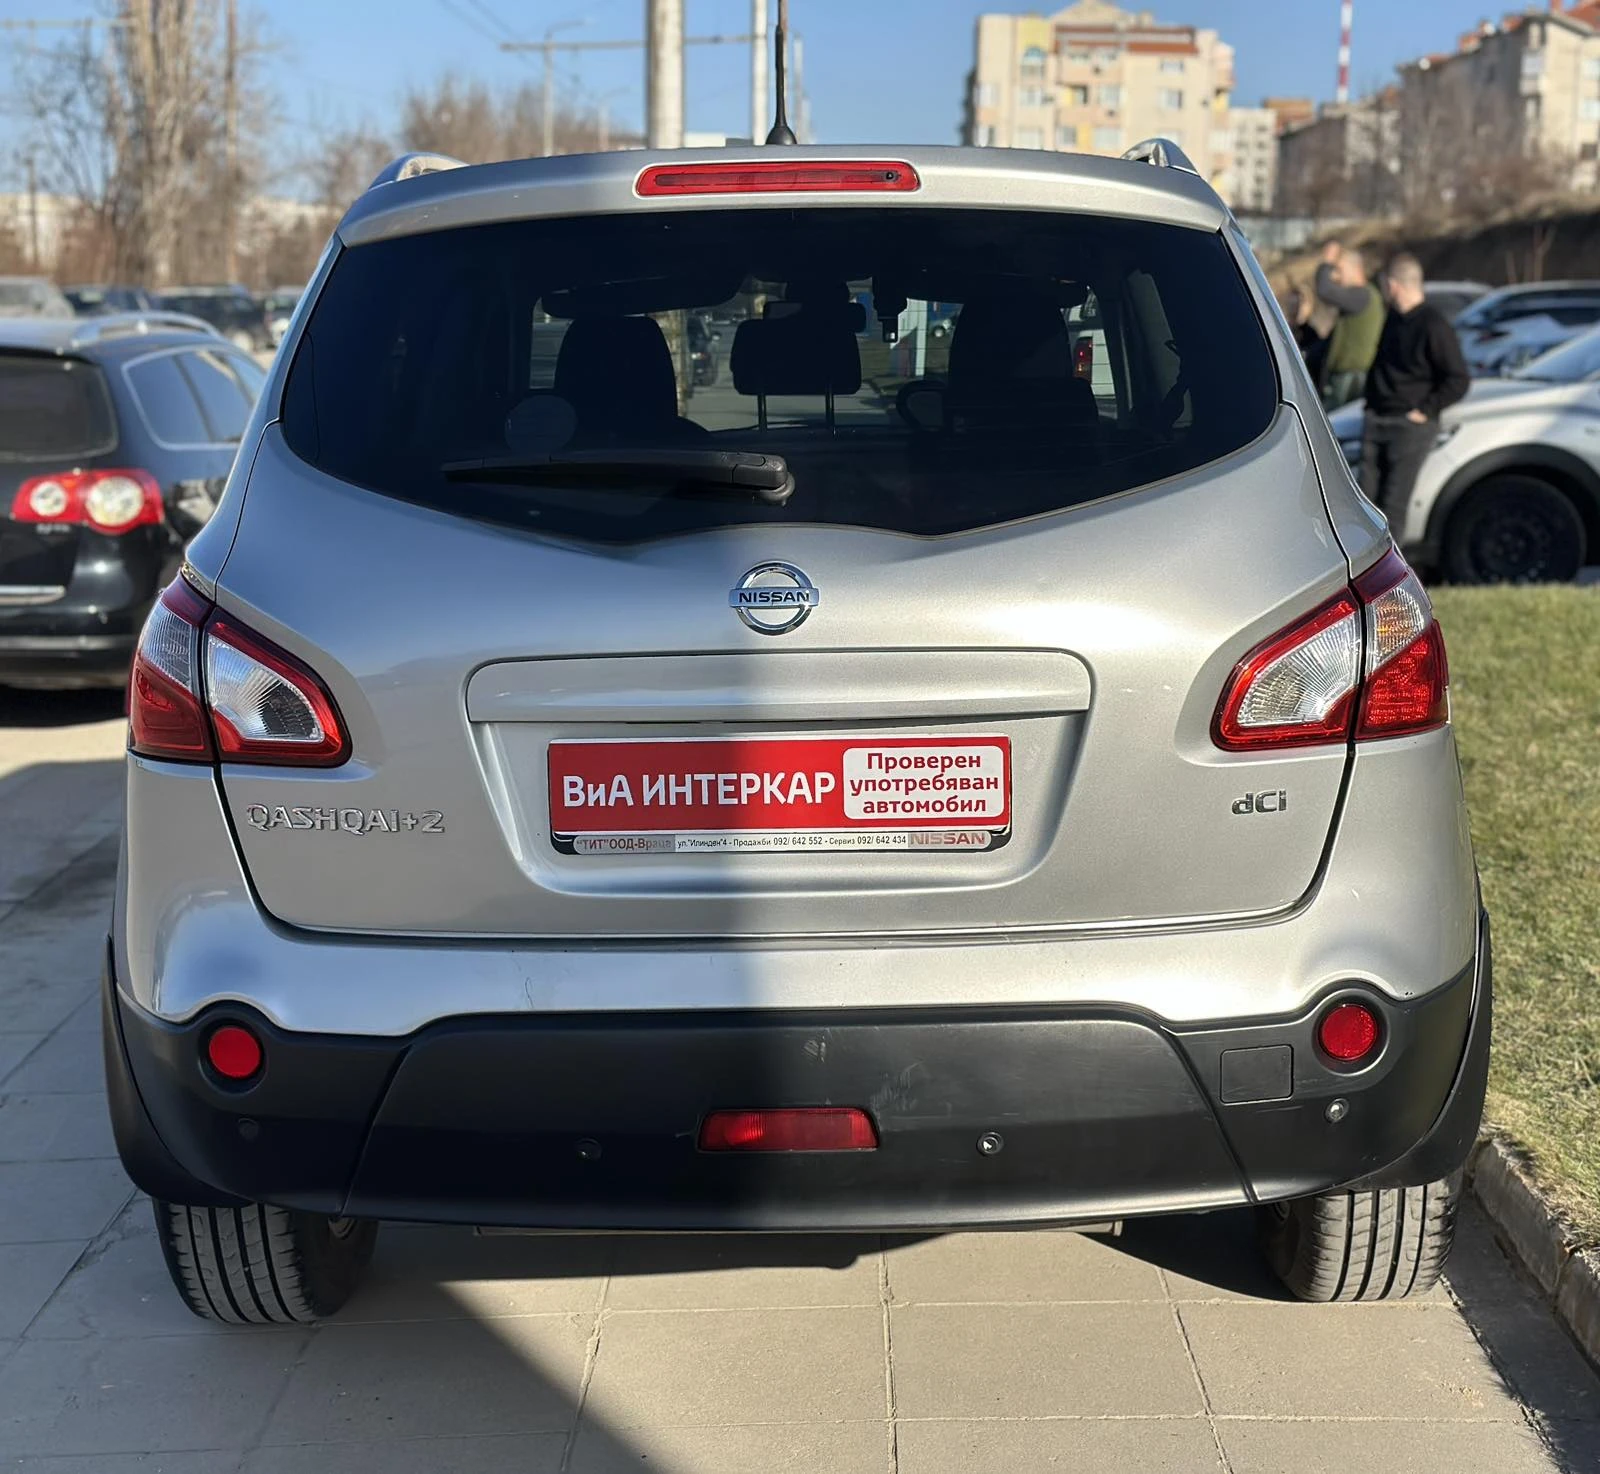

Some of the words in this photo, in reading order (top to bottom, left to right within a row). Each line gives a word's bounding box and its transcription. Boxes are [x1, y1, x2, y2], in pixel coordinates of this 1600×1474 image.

[739, 591, 810, 603] NISSAN
[867, 752, 982, 774] Проверен
[562, 774, 635, 808] ВиА
[642, 771, 836, 806] ИНТЕРКАР
[849, 773, 999, 797] употребяван
[862, 795, 987, 814] автомобил
[1231, 789, 1287, 815] dCi
[792, 836, 807, 846] 642
[808, 836, 823, 846] 552
[876, 835, 890, 845] 642
[892, 835, 907, 845] 434
[909, 832, 986, 845] NISSAN
